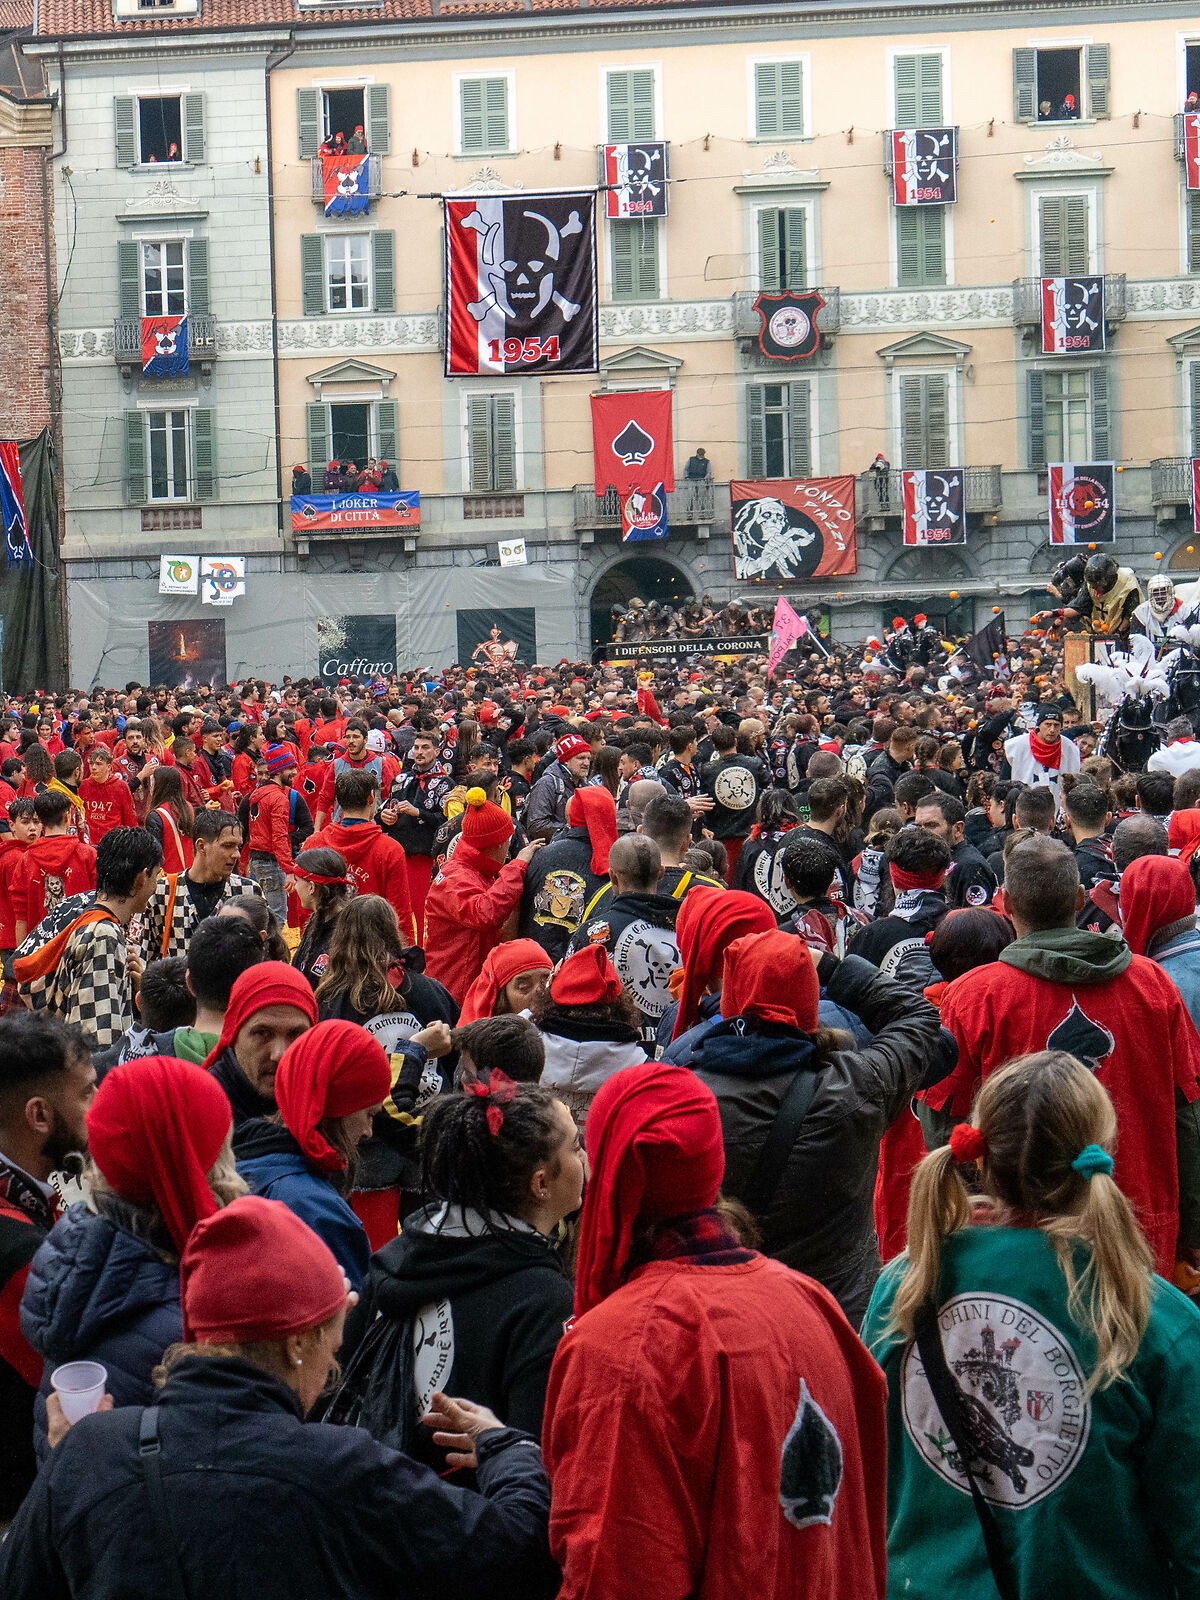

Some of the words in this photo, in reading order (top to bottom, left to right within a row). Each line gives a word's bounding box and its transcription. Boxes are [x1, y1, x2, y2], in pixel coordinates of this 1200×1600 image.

[911, 187, 942, 200] 1954
[622, 201, 653, 213] 1954
[1059, 335, 1090, 348] 1954
[487, 334, 561, 363] 1954
[332, 500, 336, 510] I
[338, 498, 378, 509] JOKER
[794, 485, 852, 521] FONDO
[1094, 498, 1110, 509] 54
[330, 513, 342, 522] DI
[803, 501, 846, 551] PIAZZA
[920, 528, 951, 540] 1954
[615, 648, 619, 656] I
[621, 645, 676, 656] DIFENSORI
[679, 643, 714, 653] DELLA
[717, 641, 762, 651] CORONA
[322, 658, 394, 677] Caffaro
[87, 800, 113, 812] 1947
[617, 933, 635, 973] Storico
[1001, 1309, 1040, 1344] DEL
[1036, 1346, 1081, 1481] BORGHETTO
